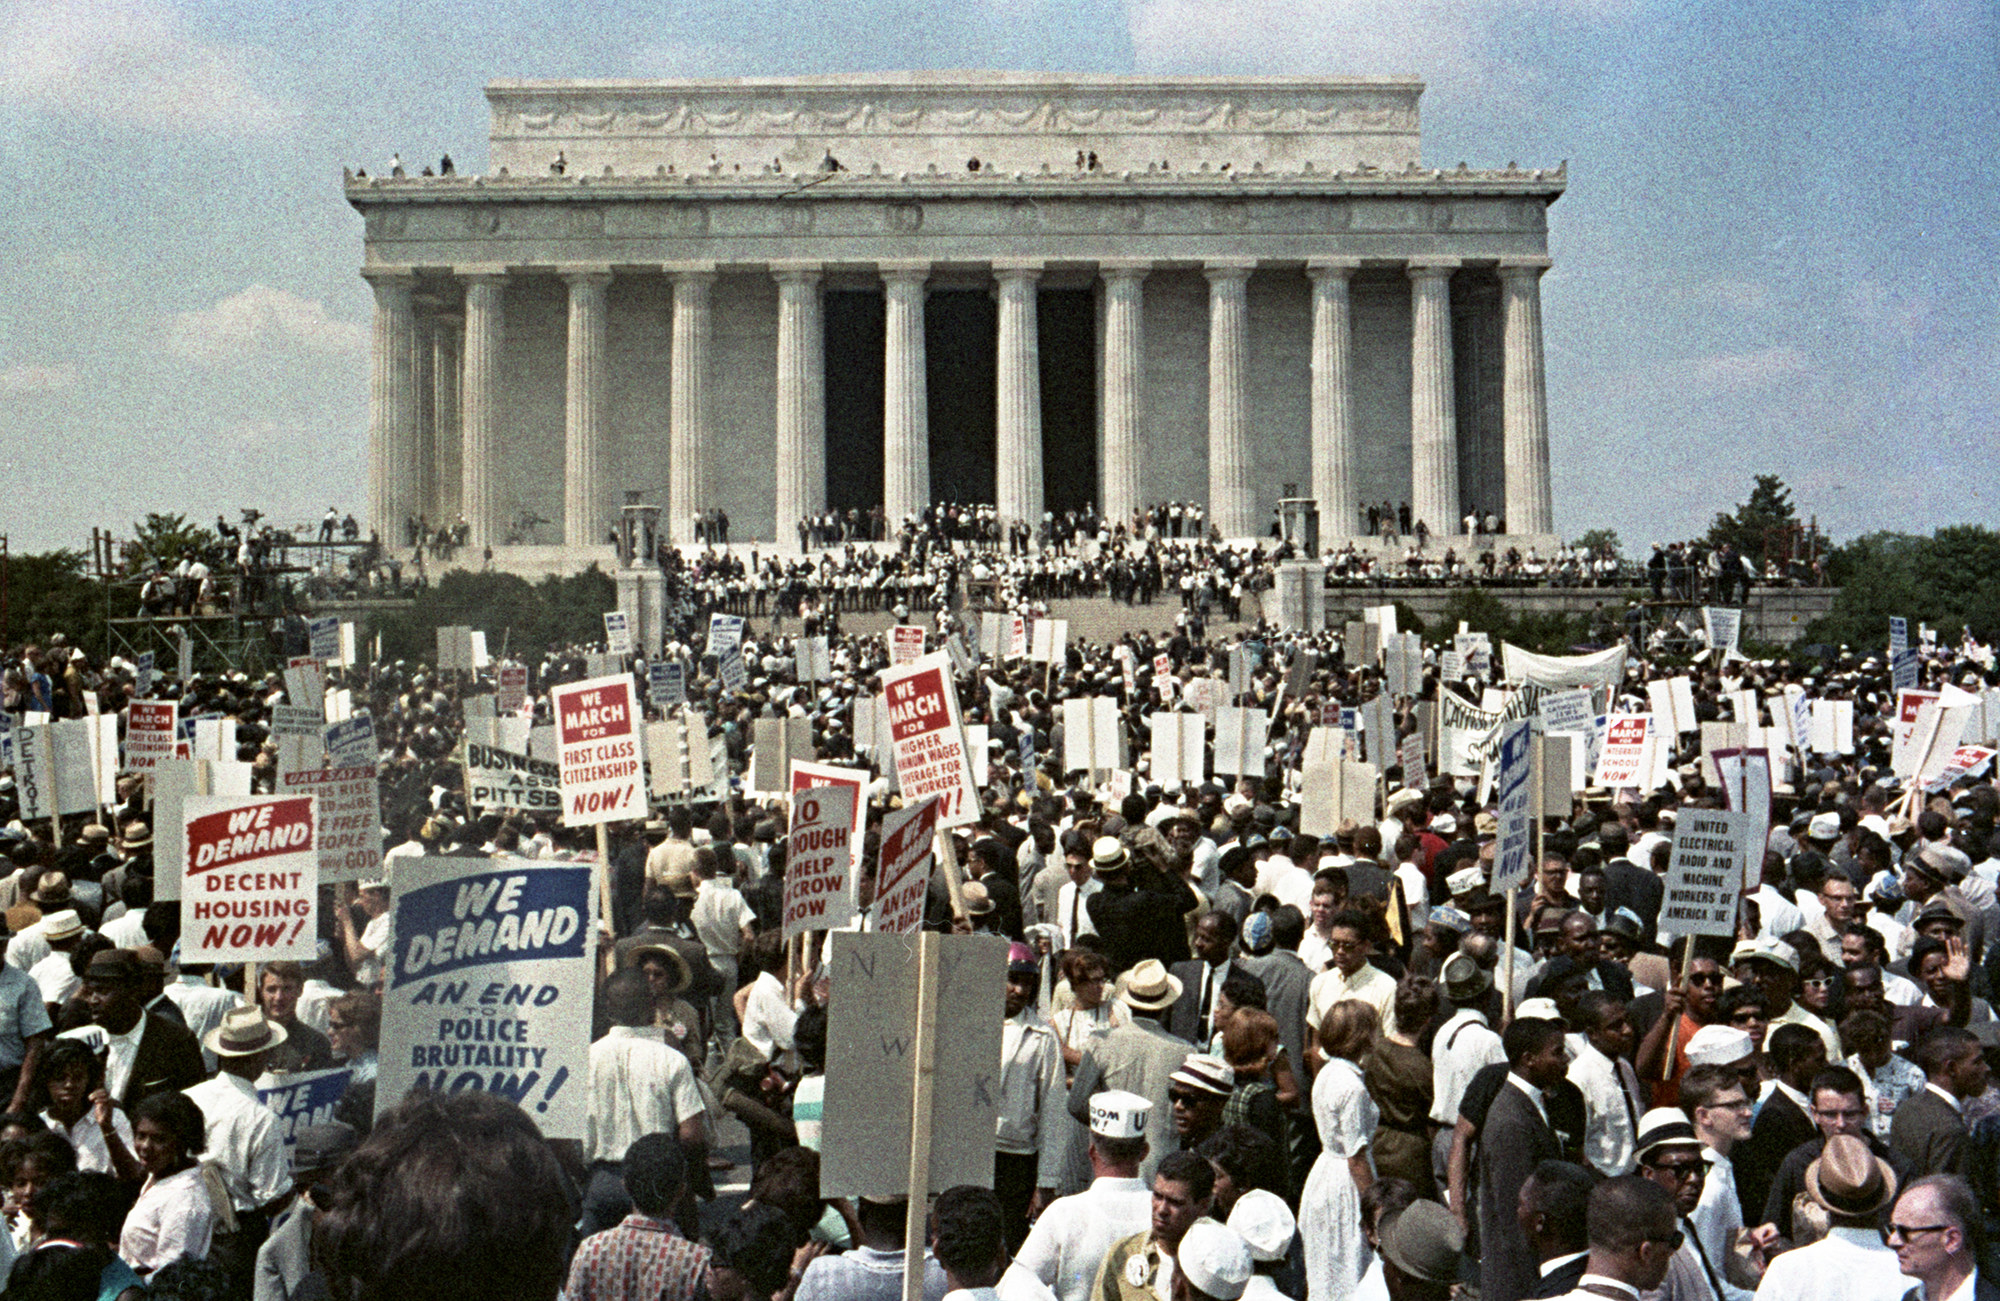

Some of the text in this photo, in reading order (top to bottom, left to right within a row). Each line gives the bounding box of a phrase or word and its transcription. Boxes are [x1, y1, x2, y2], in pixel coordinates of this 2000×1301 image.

[580, 691, 602, 707] WE
[894, 681, 916, 699] WE
[132, 715, 170, 724] MARCH
[142, 706, 156, 714] WE
[565, 704, 624, 730] MARCH
[147, 733, 173, 742] CLASS
[582, 727, 606, 738] FOR
[903, 721, 925, 735] FOR
[1610, 728, 1643, 738] MARCH
[564, 741, 634, 766] FIRST CLASS
[928, 742, 961, 763] WAGES
[1602, 759, 1640, 767] SCHOOLS
[563, 760, 638, 785] CITIZENSHIP
[941, 760, 962, 775] FOR
[1602, 769, 1636, 781] NOW!
[915, 773, 962, 795] WORKERS
[573, 784, 634, 815] NOW!
[228, 805, 274, 834] WE
[1693, 821, 1729, 835] UNITED
[196, 822, 309, 868] DEMAND
[345, 849, 379, 870] GOD
[794, 856, 835, 879] HELP
[1678, 854, 1733, 870] RADIO AND
[206, 872, 302, 892] DECENT
[1682, 872, 1725, 887] MACHINE
[454, 876, 527, 921] WE
[881, 878, 925, 918] AN END
[1670, 889, 1733, 905] WORKERS OF
[194, 899, 311, 920] HOUSING
[1666, 907, 1708, 921] AMERICA
[202, 918, 305, 950] NOW!
[403, 905, 579, 975] DEMAND
[411, 982, 560, 1007] AN END
[464, 1007, 498, 1016] TO
[438, 1018, 528, 1043] POLICE
[411, 1045, 547, 1068] BRUTALITY
[266, 1084, 312, 1115] WE
